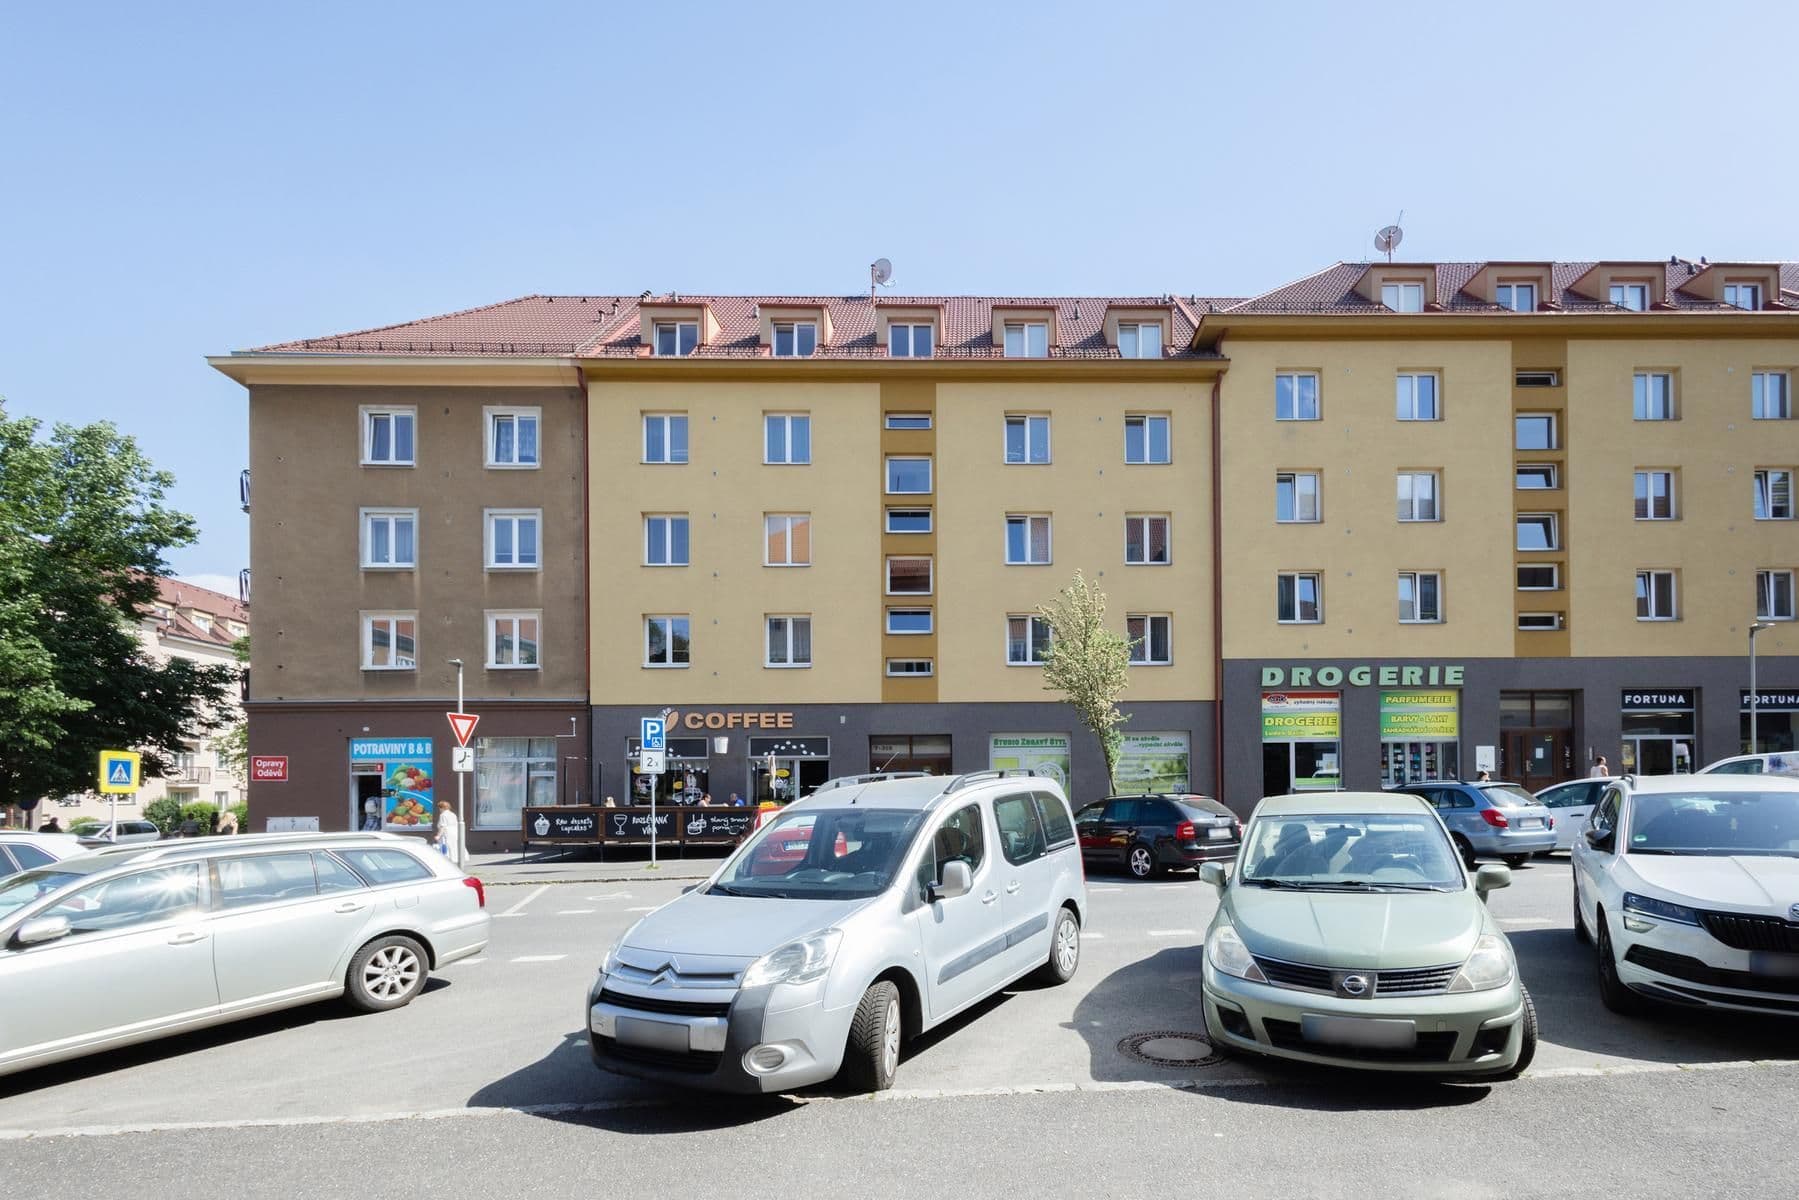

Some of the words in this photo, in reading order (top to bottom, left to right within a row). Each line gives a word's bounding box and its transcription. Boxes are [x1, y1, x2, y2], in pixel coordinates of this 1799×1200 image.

[1261, 666, 1465, 687] DROGERIE
[1385, 695, 1452, 704] PARFUMERIE
[1624, 695, 1686, 704] FORTUNA
[684, 712, 793, 729] COFFEE
[1264, 716, 1338, 726] DROGERIE
[646, 721, 660, 740] P
[993, 738, 1019, 746] STUDIO
[353, 743, 406, 755] POTRAVINY
[408, 743, 415, 754] B
[416, 743, 424, 754] &
[424, 743, 432, 754] B
[256, 759, 285, 769] Opravy
[257, 768, 283, 777] Oděvů
